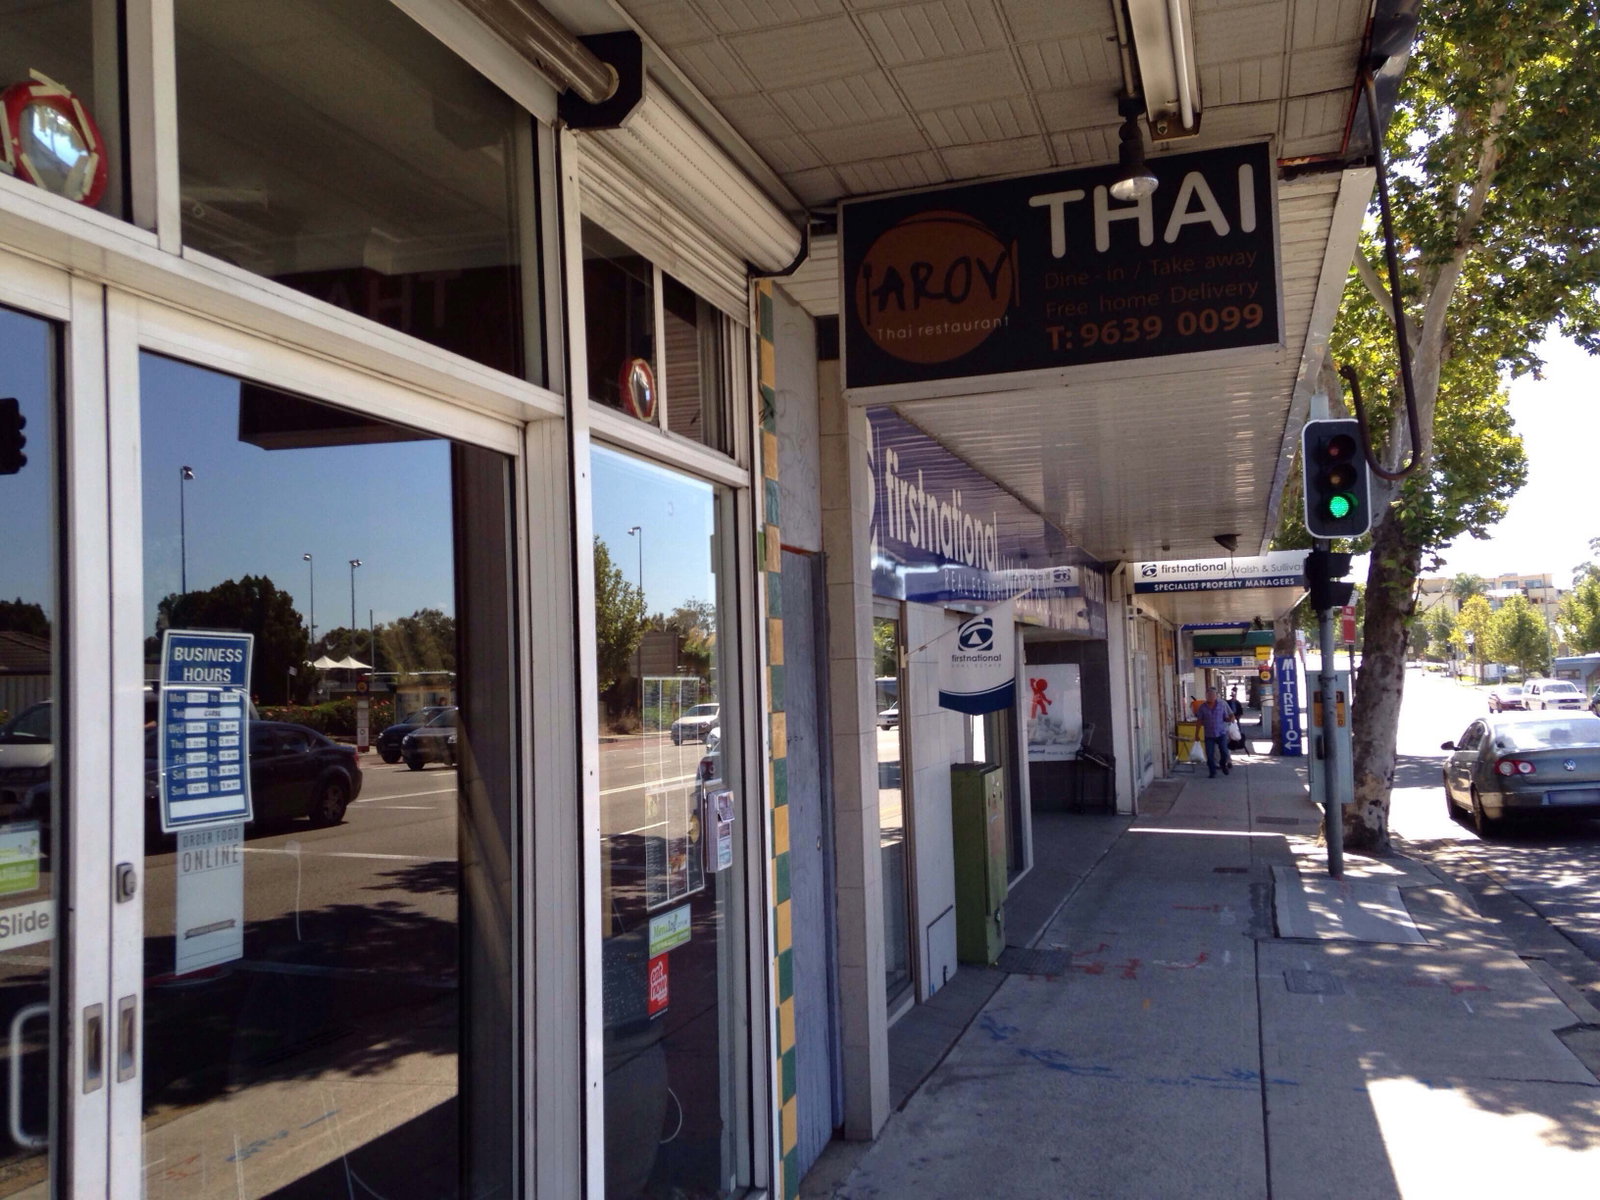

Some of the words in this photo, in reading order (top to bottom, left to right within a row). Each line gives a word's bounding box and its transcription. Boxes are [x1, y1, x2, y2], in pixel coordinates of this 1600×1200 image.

[1029, 163, 1256, 259] THAI
[1152, 258, 1195, 276] Take
[1205, 251, 1257, 270] away
[872, 250, 1008, 312] AROY
[1046, 302, 1089, 319] Free
[1100, 294, 1160, 313] home
[1171, 280, 1259, 304] Delivery
[877, 325, 912, 341] Thai
[918, 316, 1009, 336] restaurant
[1177, 303, 1264, 336] 0099
[886, 447, 999, 574] firstnational
[1161, 562, 1227, 574] firstnational
[1262, 564, 1269, 573] &
[1271, 561, 1304, 573] Sulliva
[944, 568, 969, 596] REAL
[1154, 582, 1199, 591] SPECIALIST
[1201, 580, 1242, 589] PROPERTY
[1245, 577, 1295, 587] MANAGERS
[174, 647, 243, 663] BUSINESS
[951, 654, 1002, 663] firstnational
[183, 667, 232, 682] HOURS
[1281, 659, 1295, 716] MITRE
[1285, 718, 1299, 741] 10
[183, 832, 212, 848] ORDER
[216, 827, 239, 843] FOOD
[183, 843, 239, 873] ONLINE
[0, 910, 50, 939] Slide
